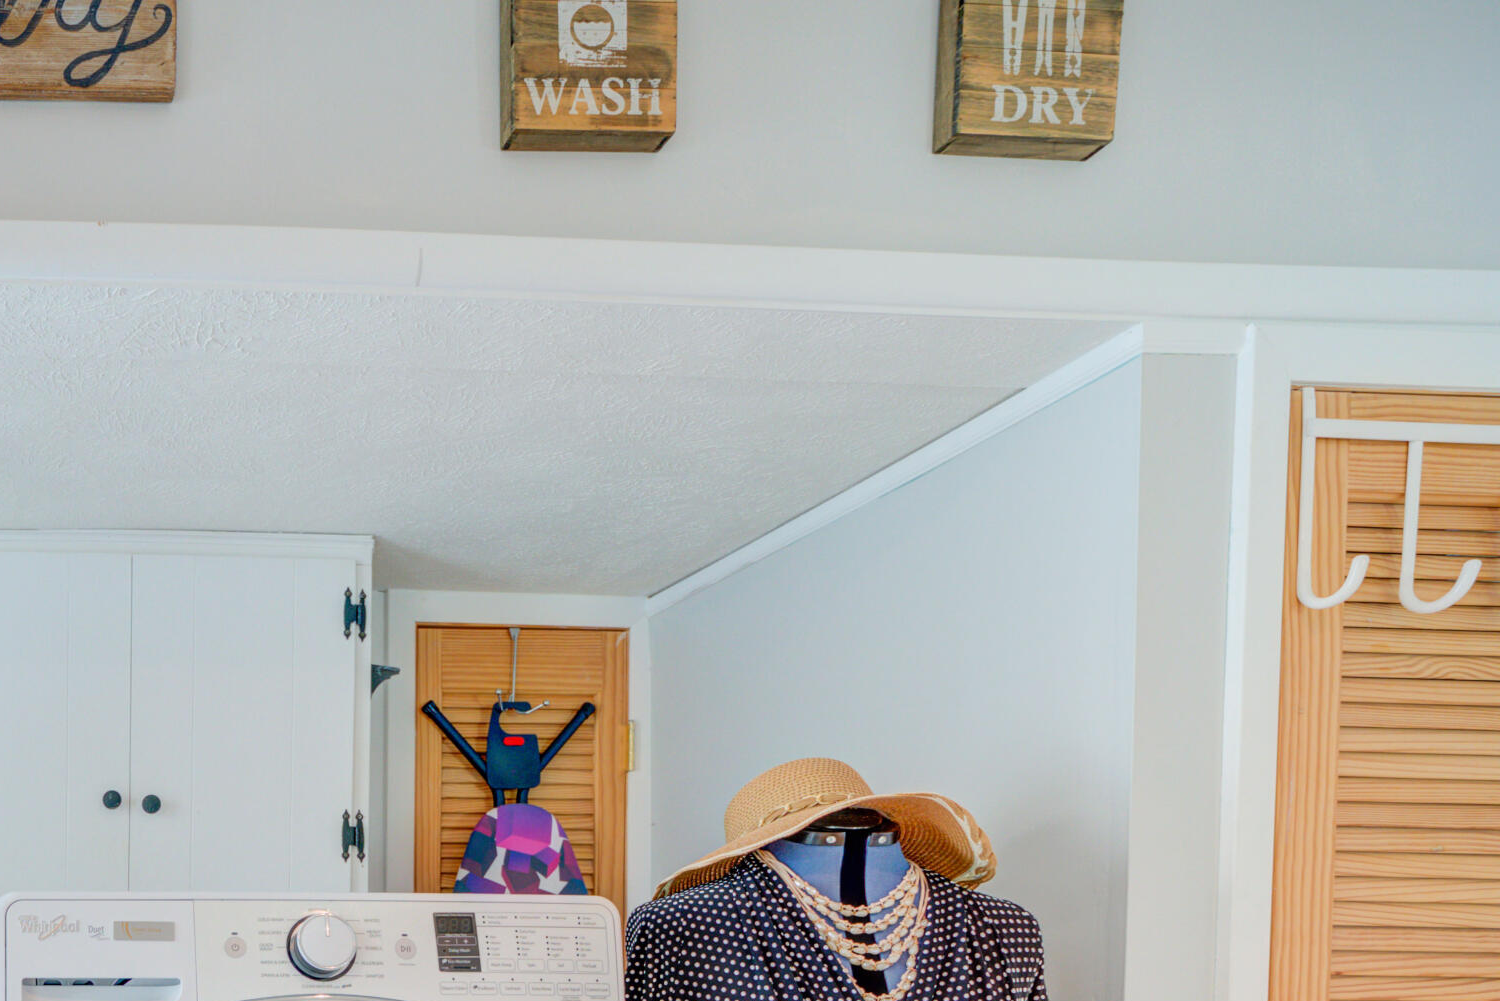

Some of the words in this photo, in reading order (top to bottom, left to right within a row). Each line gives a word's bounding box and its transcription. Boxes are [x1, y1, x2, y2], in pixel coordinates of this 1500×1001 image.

[523, 77, 663, 116] WASH
[991, 84, 1096, 126] DRY
[18, 914, 80, 937] Whirlpool
